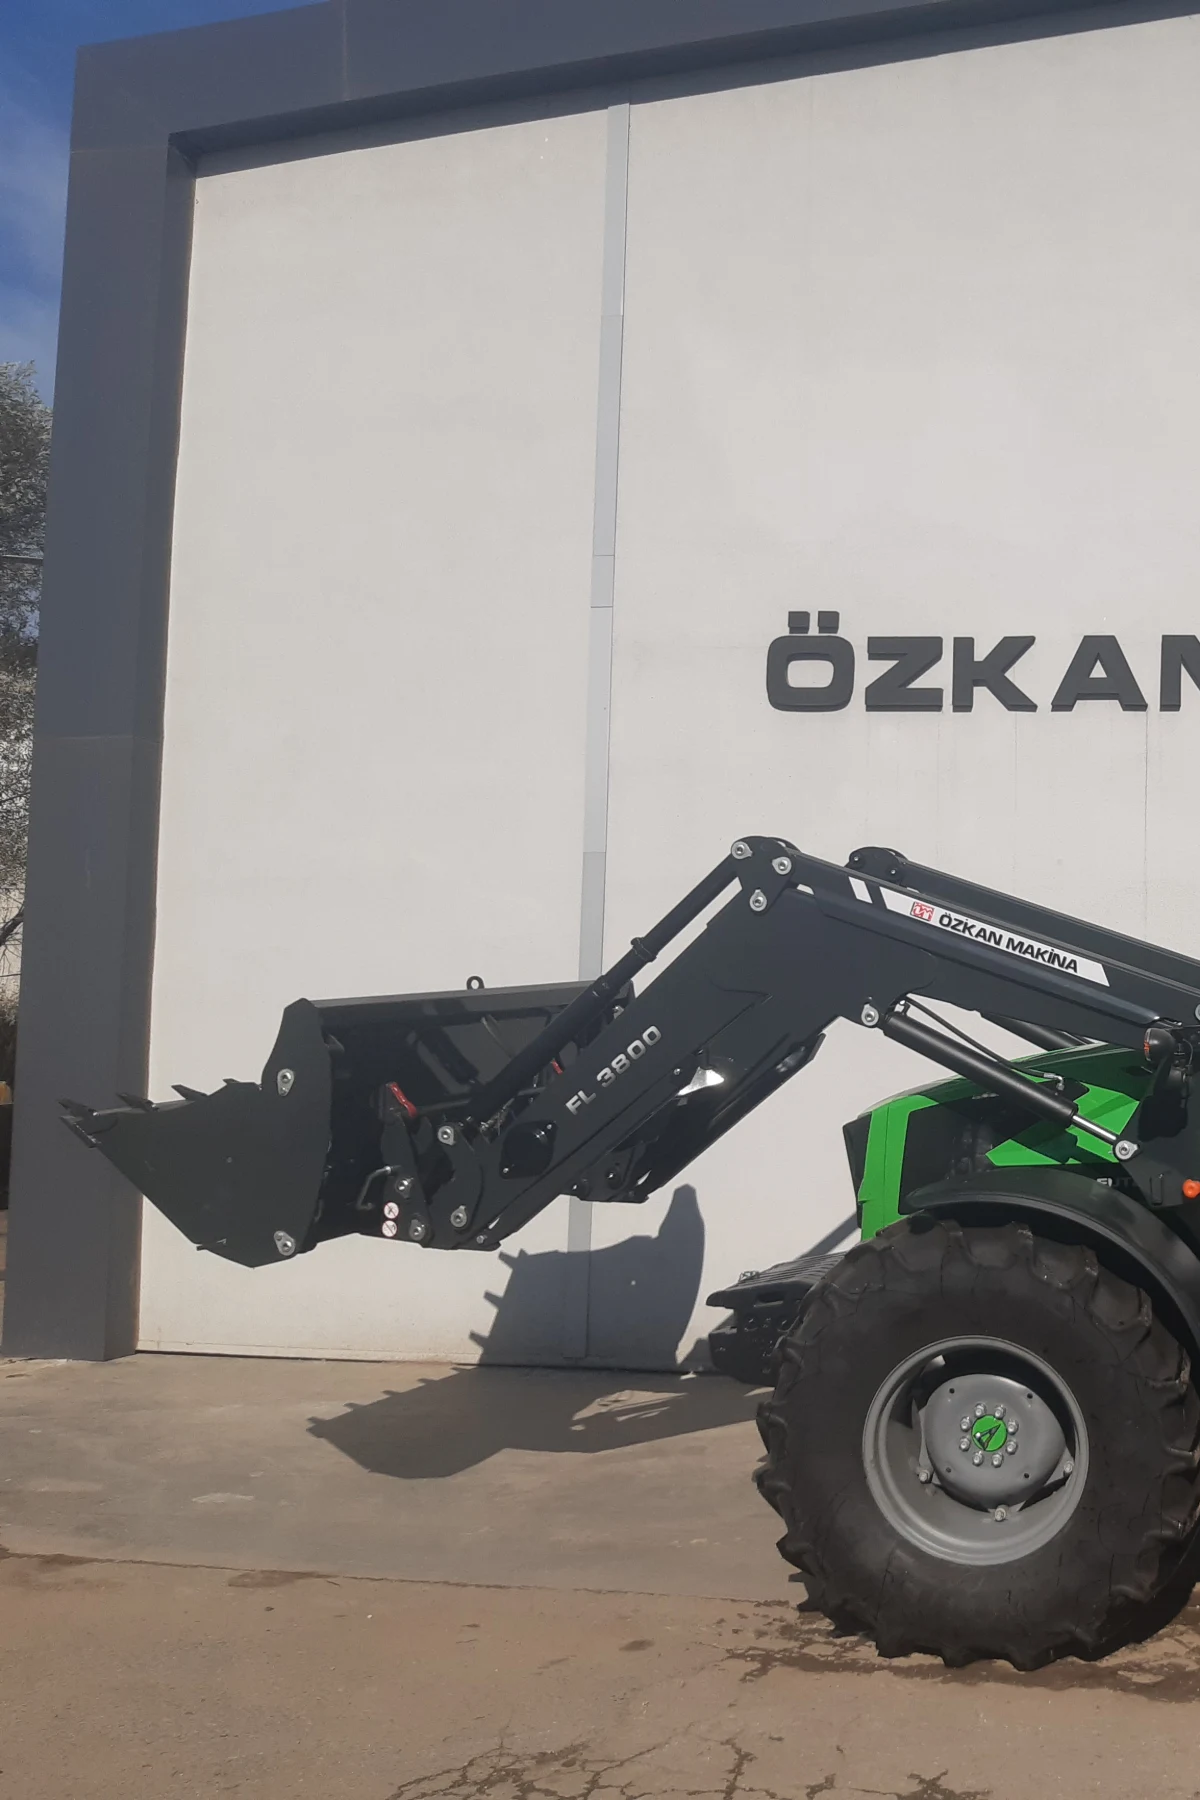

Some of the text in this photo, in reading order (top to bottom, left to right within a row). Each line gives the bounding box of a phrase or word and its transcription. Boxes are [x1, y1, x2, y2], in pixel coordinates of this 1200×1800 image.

[938, 911, 1079, 974] ÖZKAN MAKİNA
[565, 1025, 662, 1115] FL 3800
